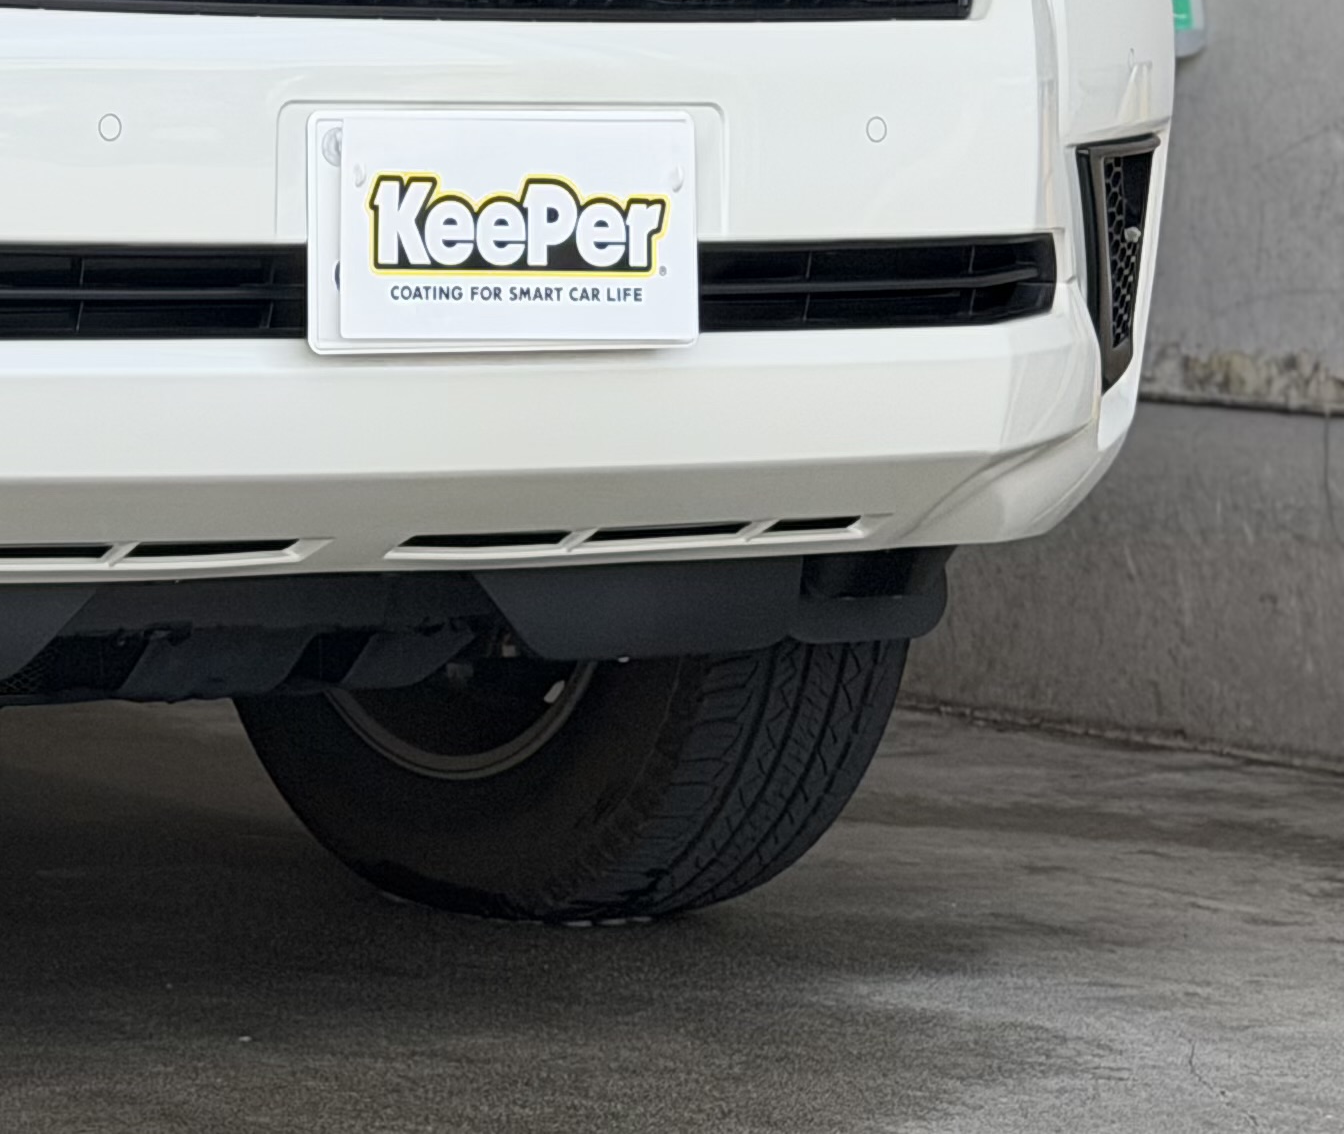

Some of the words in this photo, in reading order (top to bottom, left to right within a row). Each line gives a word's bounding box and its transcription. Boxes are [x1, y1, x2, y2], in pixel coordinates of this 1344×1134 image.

[369, 174, 669, 275] KeePer
[390, 285, 464, 302] COATING
[470, 286, 503, 302] FOR
[509, 286, 563, 303] SMART
[569, 286, 601, 303] CAR
[606, 287, 643, 303] LIFE
